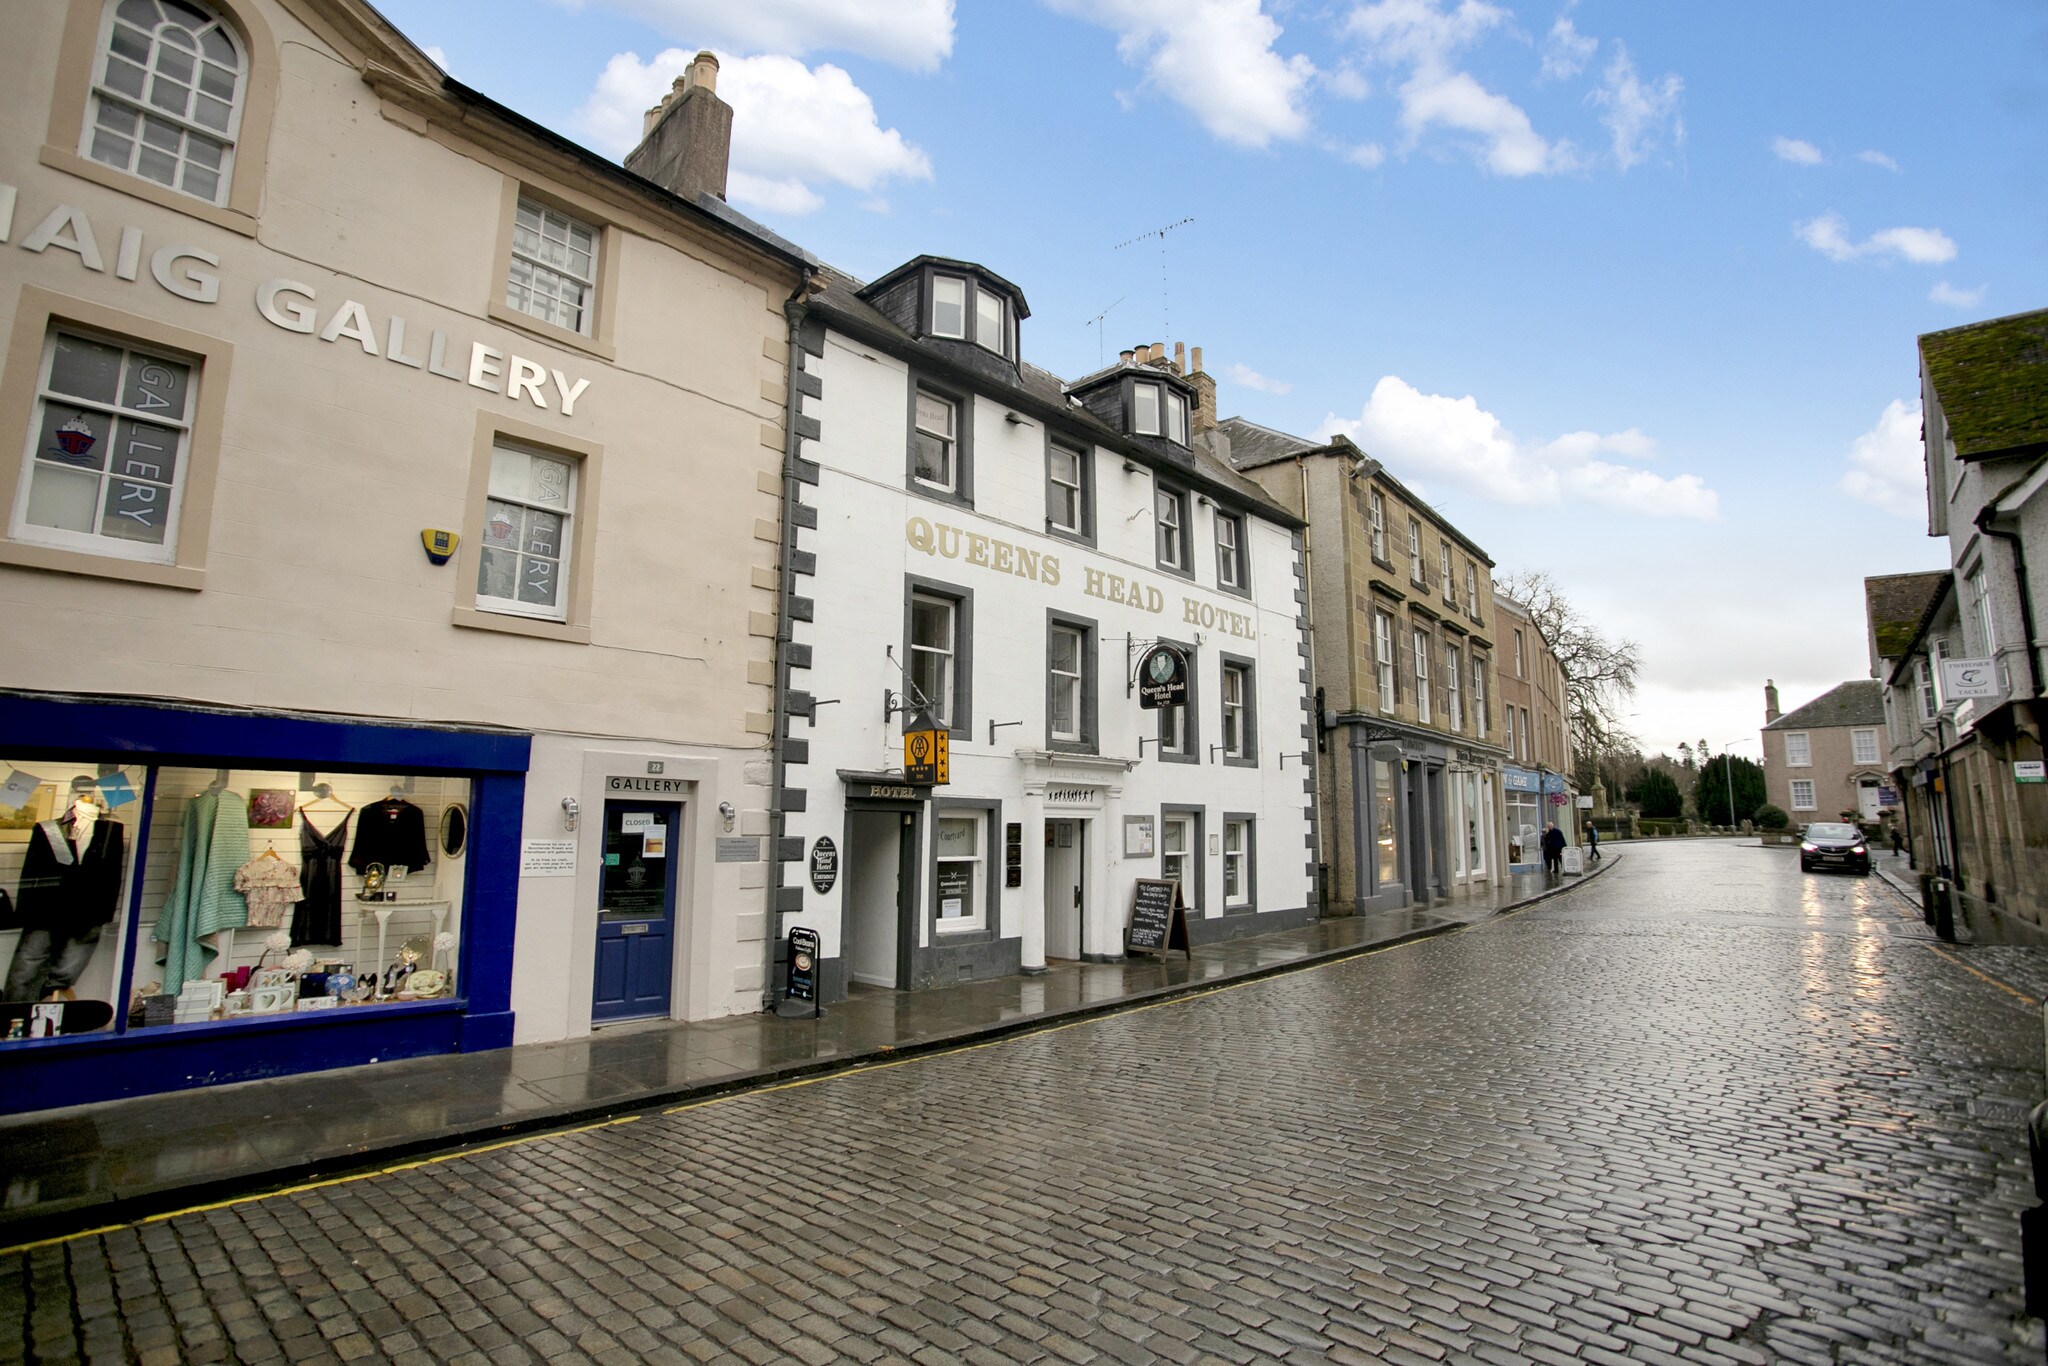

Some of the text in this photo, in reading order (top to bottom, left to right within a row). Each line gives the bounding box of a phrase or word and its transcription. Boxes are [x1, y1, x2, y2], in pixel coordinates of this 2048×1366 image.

[256, 278, 591, 416] GALLERY
[118, 363, 175, 528] GALLERY
[528, 465, 563, 594] GALLERY
[906, 516, 1257, 641] QUEENS HEAD HOTEL
[1141, 683, 1184, 696] Queen's Head
[1154, 692, 1172, 700] Hotel
[611, 778, 681, 792] GALLERY
[870, 785, 917, 799] HOTEL
[940, 827, 966, 842] Courtyard
[813, 850, 836, 860] Queens
[793, 937, 802, 945] Cool
[802, 938, 814, 948] Beans
